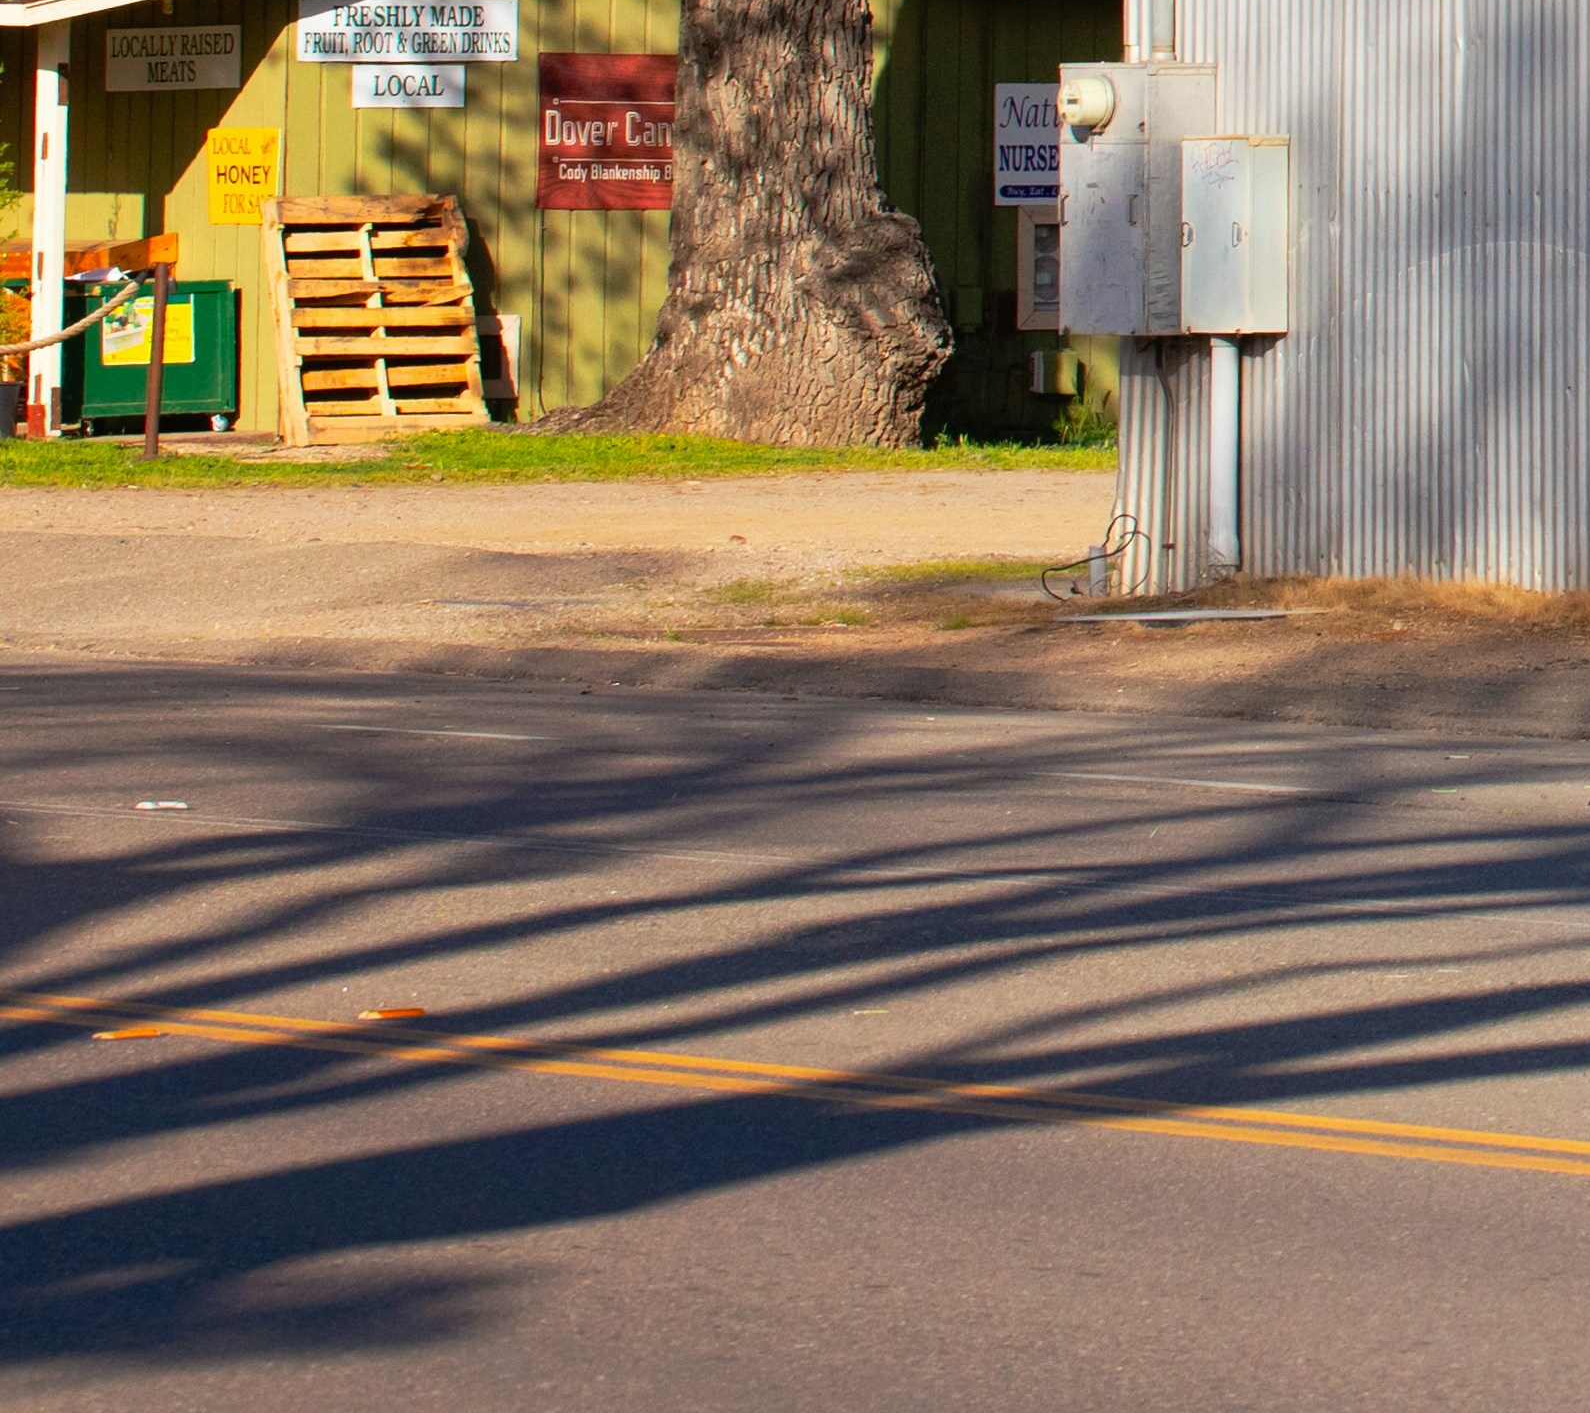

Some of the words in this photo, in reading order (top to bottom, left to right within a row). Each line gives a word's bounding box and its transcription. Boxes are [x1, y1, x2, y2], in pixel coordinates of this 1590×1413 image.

[333, 5, 426, 27] FRESHLY
[430, 5, 485, 27] MADE
[111, 34, 178, 58] LOCALLY
[181, 32, 235, 56] RAISED
[304, 32, 349, 57] FRUIT,
[353, 32, 393, 54] ROOT
[397, 32, 408, 54] &
[412, 32, 458, 54] GREEN
[461, 32, 511, 54] DRINKS
[147, 60, 197, 83] MEATS
[374, 74, 445, 97] LOCAL
[545, 109, 619, 146] Dover
[625, 111, 676, 147] Can
[213, 137, 251, 154] LOCAL
[216, 165, 271, 184] HONEY
[559, 163, 588, 183] Cody
[591, 164, 660, 183] Blankenship
[223, 194, 246, 214] FOR
[248, 194, 274, 214] SA
